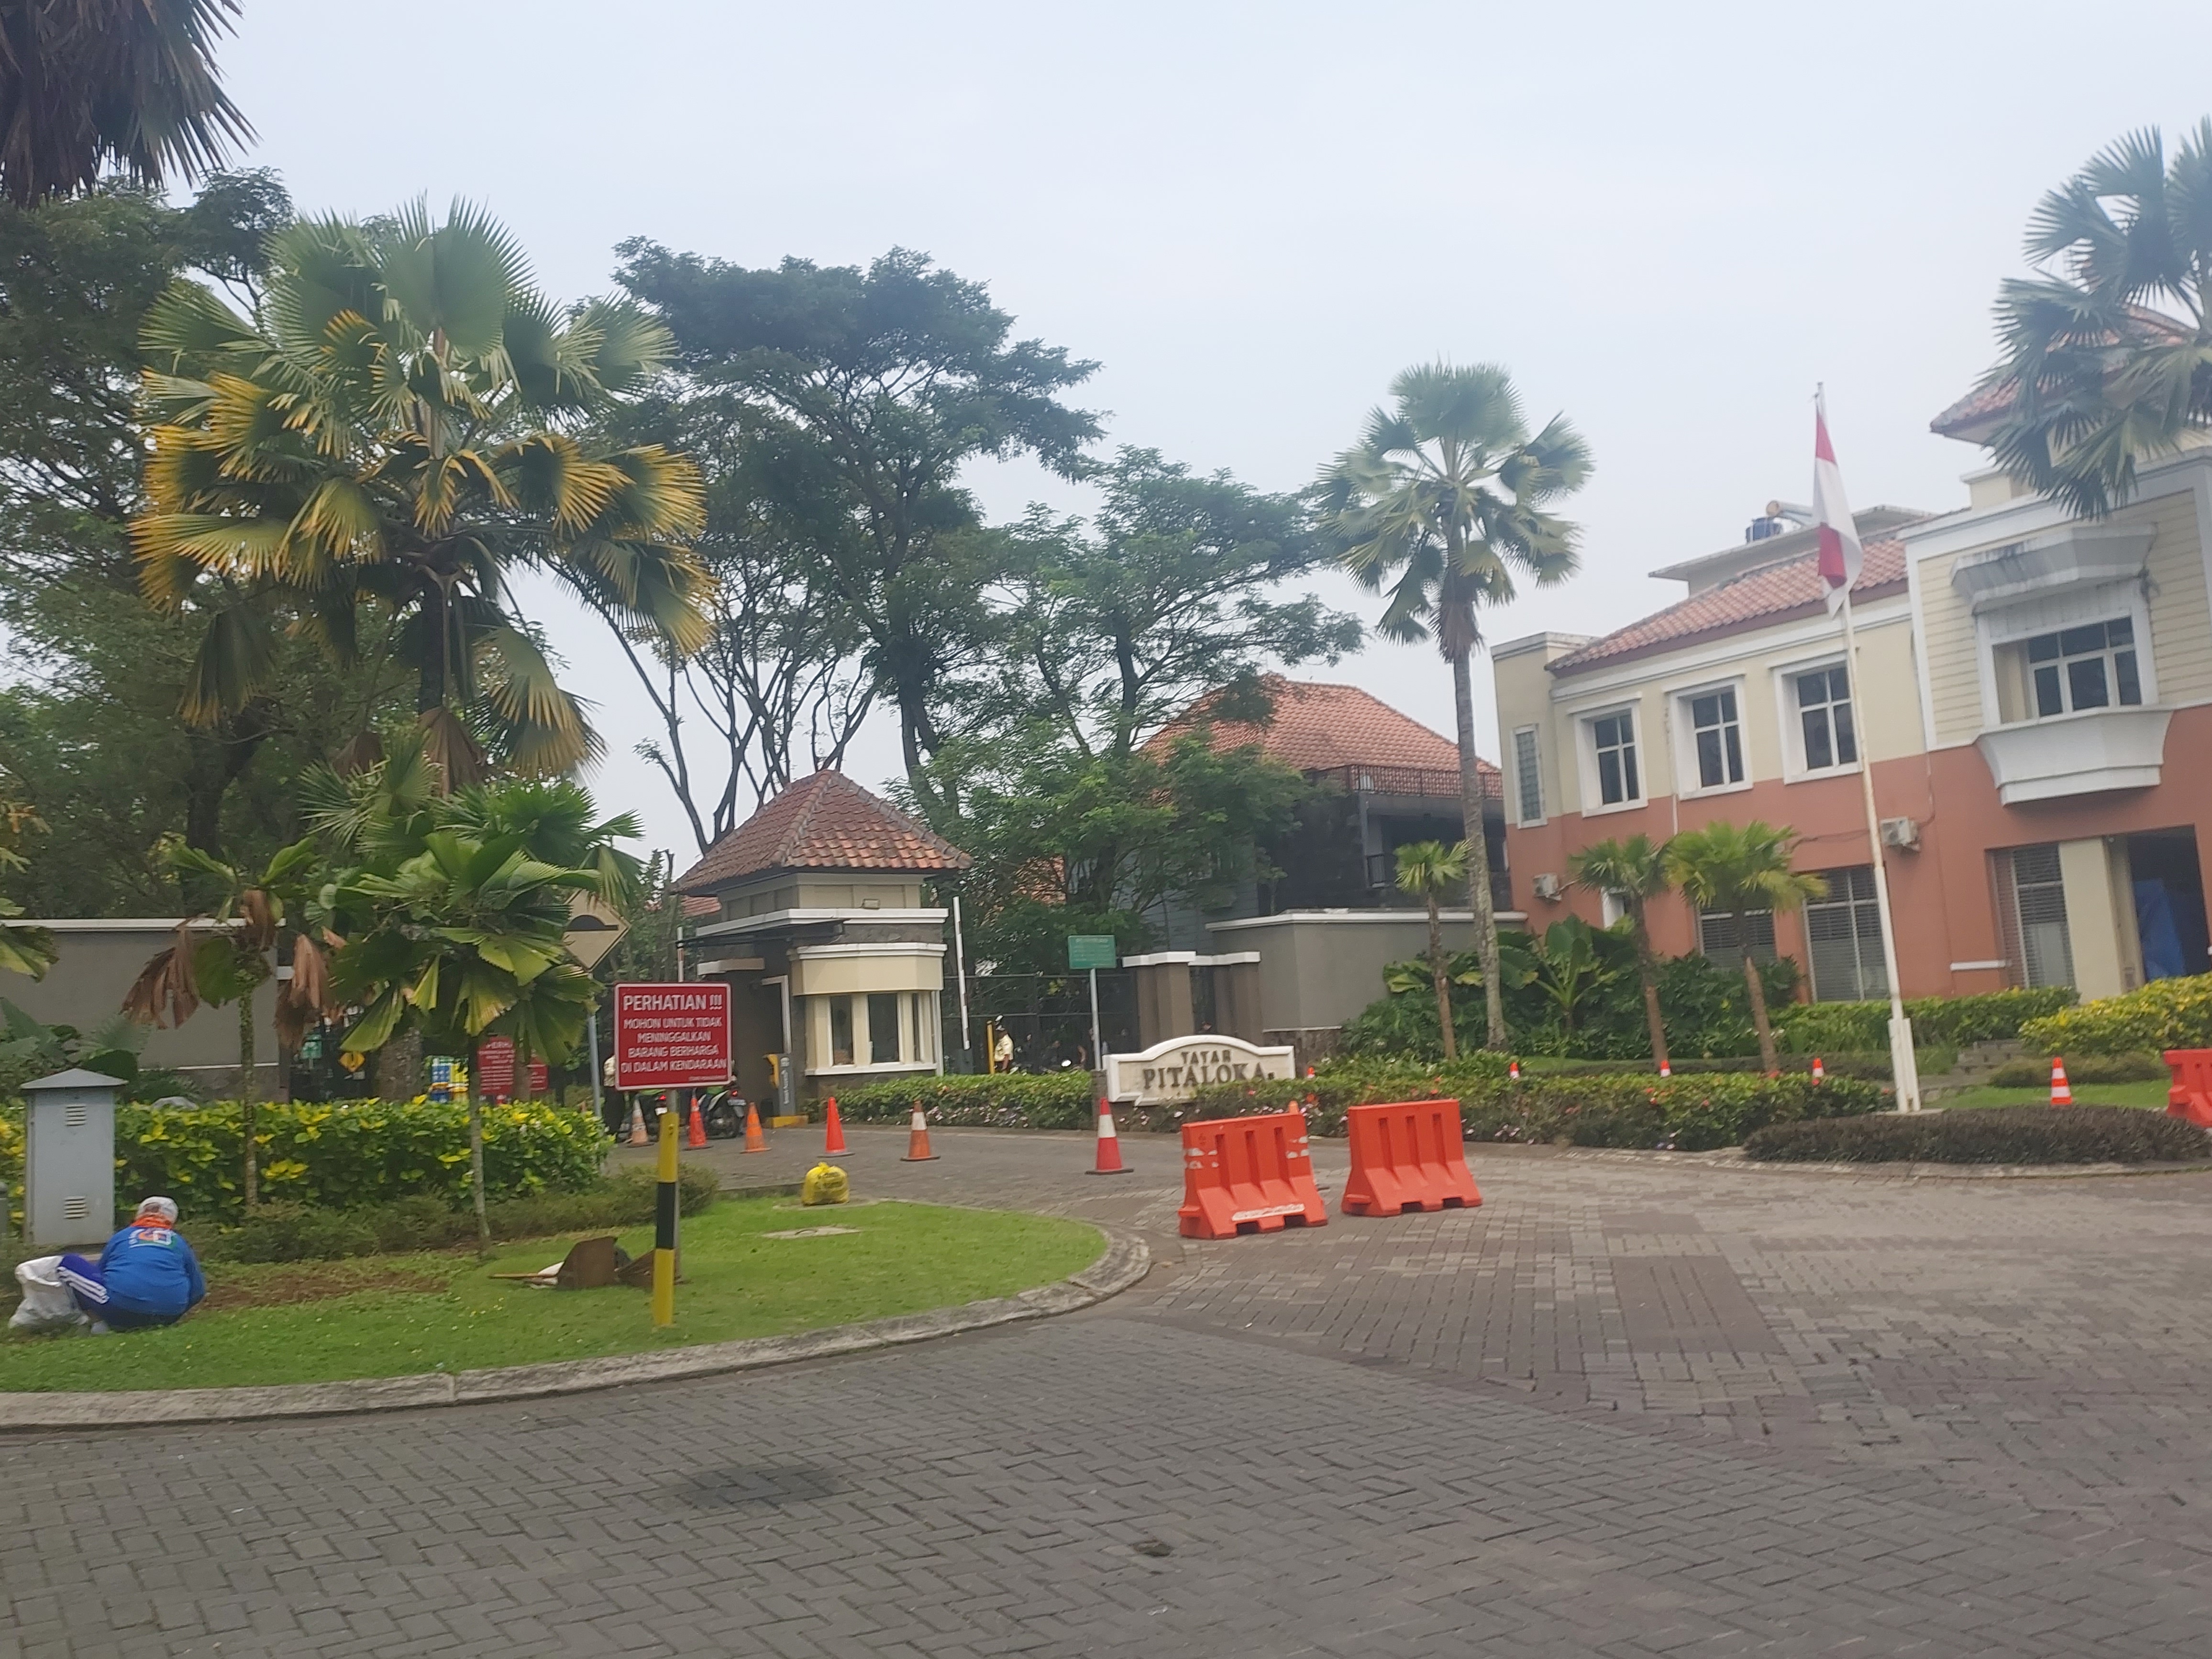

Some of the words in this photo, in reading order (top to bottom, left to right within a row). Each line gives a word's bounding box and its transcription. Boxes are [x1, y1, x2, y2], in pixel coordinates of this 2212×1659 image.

[623, 994, 707, 1011] PERHATIAN
[709, 994, 723, 1010] !!!
[624, 1018, 661, 1029] MOHON
[663, 1017, 695, 1028] UNTUK
[696, 1016, 723, 1028] TIDAK
[637, 1031, 711, 1043] MENINGGALKAN
[628, 1046, 669, 1058] BARANG
[670, 1044, 719, 1056] BERHARGA
[1181, 1050, 1231, 1064] TATAR
[621, 1062, 632, 1073] DI
[633, 1061, 669, 1073] DALAM
[670, 1058, 727, 1072] KENDARAAN
